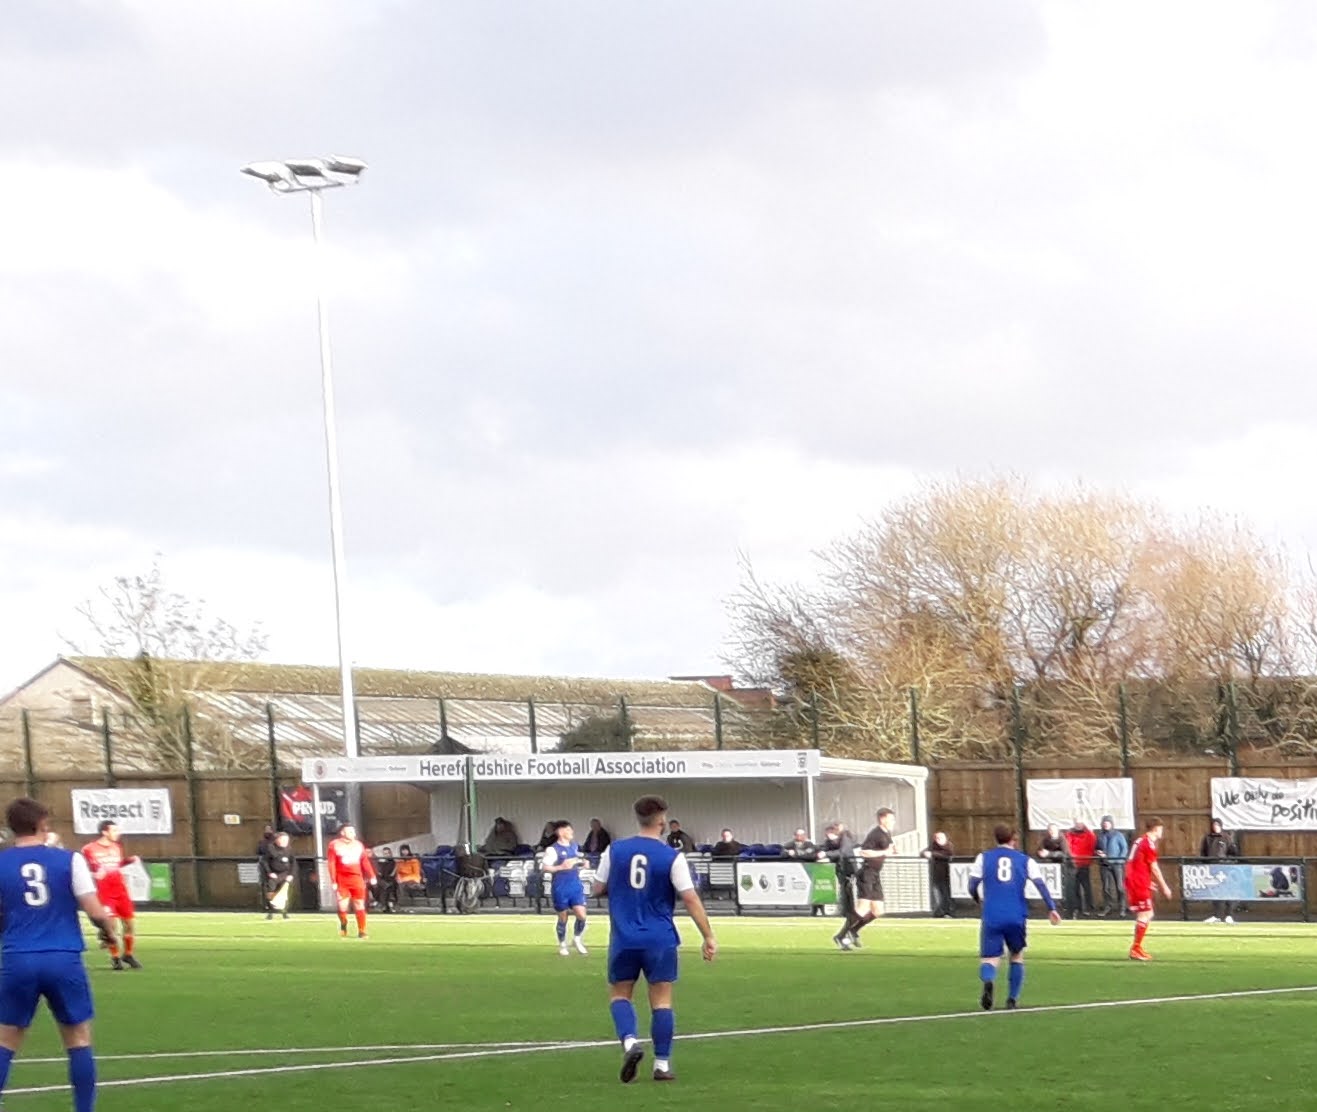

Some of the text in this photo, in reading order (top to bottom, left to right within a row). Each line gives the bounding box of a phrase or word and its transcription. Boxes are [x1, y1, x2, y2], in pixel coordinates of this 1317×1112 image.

[527, 757, 590, 776] Football
[595, 756, 686, 775] Association
[292, 801, 336, 815] PRUD
[1219, 791, 1240, 808] We
[80, 800, 144, 820] Respect
[630, 854, 648, 889] 6
[997, 857, 1012, 882] 8
[21, 863, 48, 907] 3
